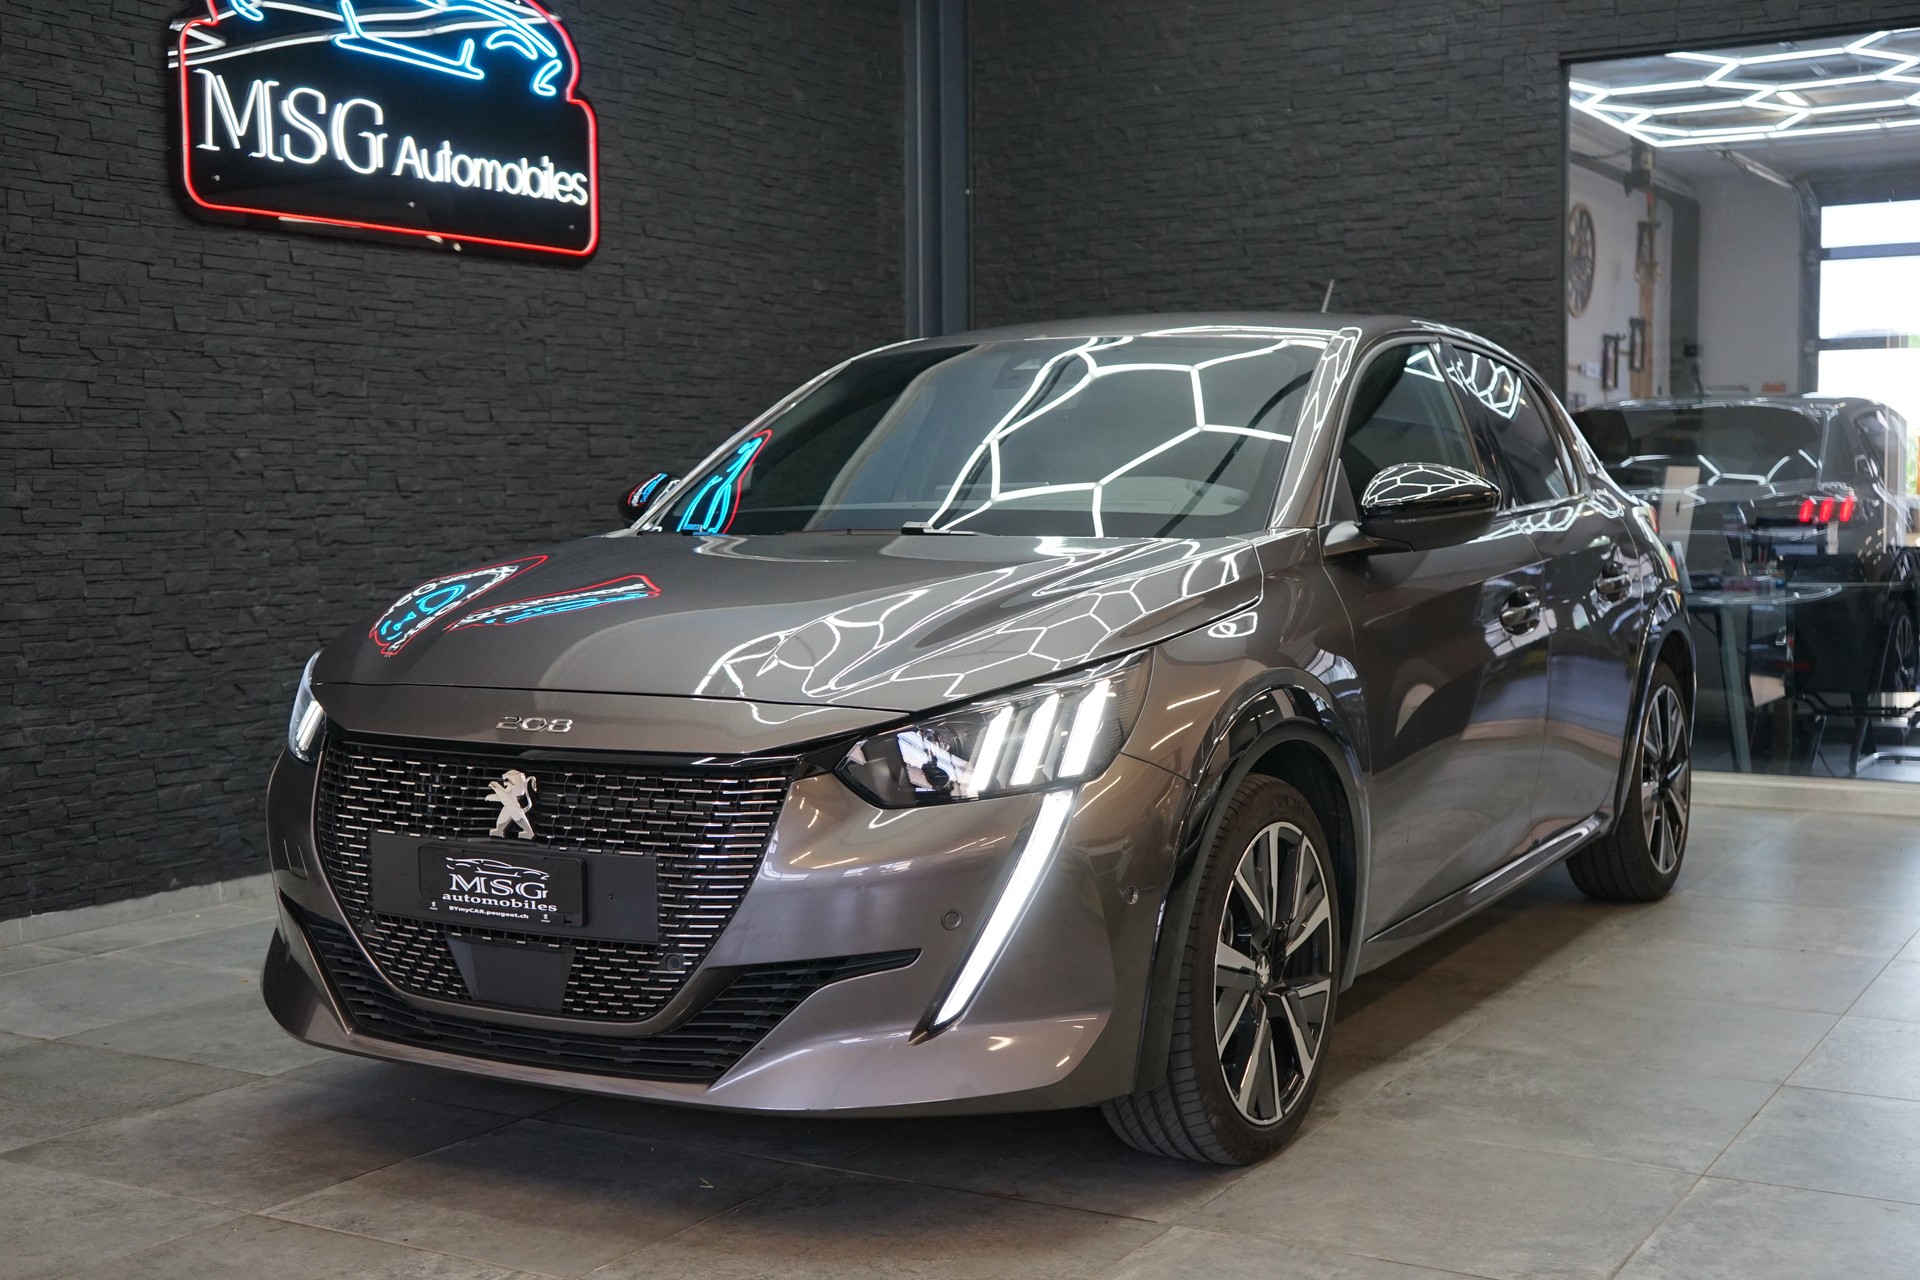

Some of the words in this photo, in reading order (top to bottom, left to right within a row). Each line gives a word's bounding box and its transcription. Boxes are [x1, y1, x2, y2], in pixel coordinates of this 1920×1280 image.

[193, 68, 389, 175] MSG
[391, 135, 589, 206] Automobiles
[495, 716, 573, 733] 208
[448, 873, 549, 899] MSG
[442, 893, 557, 912] automobiles
